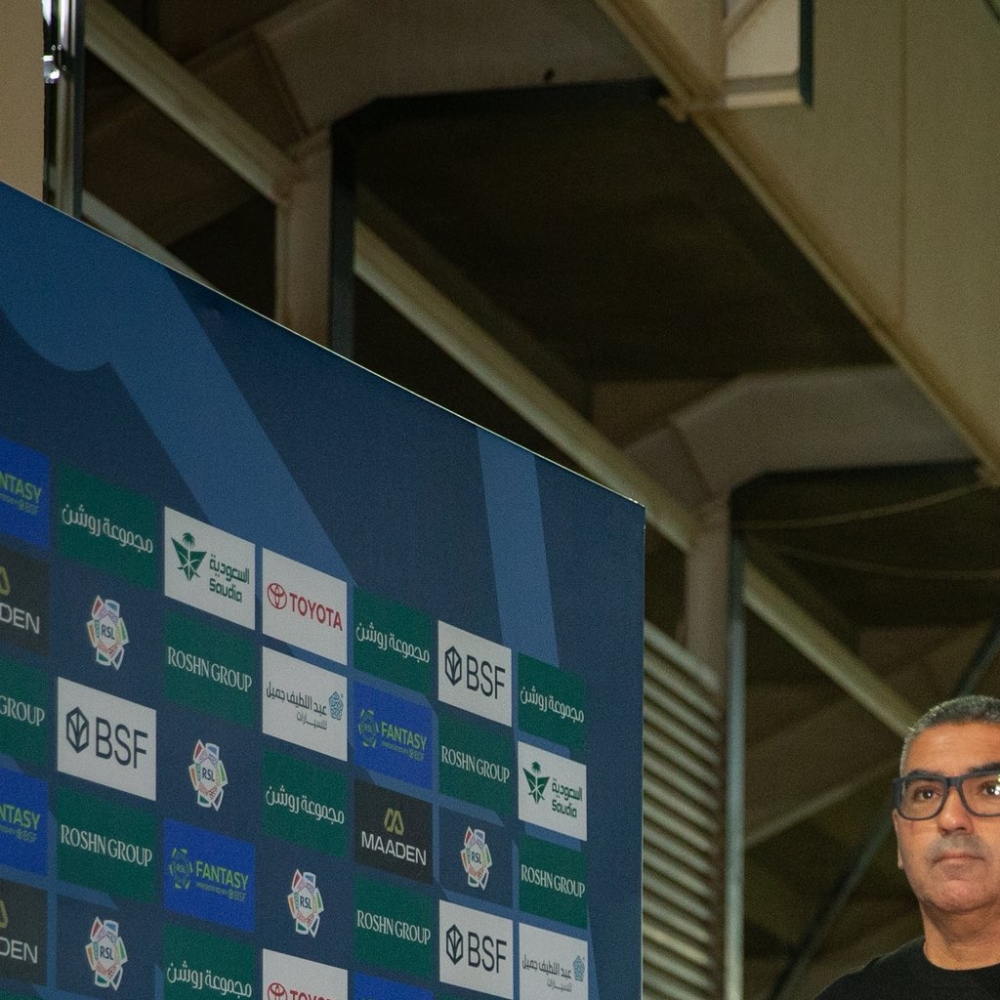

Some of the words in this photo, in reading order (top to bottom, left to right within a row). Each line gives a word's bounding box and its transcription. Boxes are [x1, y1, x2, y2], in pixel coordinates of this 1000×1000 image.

[62, 504, 101, 536] روشن
[102, 518, 153, 553] مجموعة
[209, 555, 249, 584] السعودية
[209, 578, 242, 602] Saudia
[290, 593, 342, 630] TOYOTA
[101, 624, 115, 640] RSL
[356, 622, 387, 650] روشن
[389, 633, 429, 663] مجموعة
[168, 647, 209, 677] ROSHN
[211, 663, 252, 692] GROUP
[467, 655, 505, 699] BSF
[0, 695, 45, 726] GROUP
[96, 717, 147, 768] BSF
[381, 721, 426, 750] FANTASY
[202, 767, 215, 782] RSL
[441, 745, 475, 771] ROSHN
[476, 759, 510, 783] GROUP
[265, 785, 299, 814] روشن
[300, 795, 344, 824] مجموعة
[61, 824, 106, 854] ROSHN
[108, 839, 152, 866] GROUP
[362, 831, 426, 865] MAADEN
[471, 851, 482, 864] RSL
[195, 861, 248, 890] FANTASY
[521, 864, 552, 888] ROSHN
[554, 875, 585, 898] GROUP
[300, 896, 312, 910] RSL
[357, 909, 393, 934] ROSHN
[395, 921, 431, 945] GROUP
[100, 946, 113, 960] RSL
[468, 931, 507, 973] BSF
[166, 961, 203, 990] روشن
[204, 970, 252, 998] مجموعة
